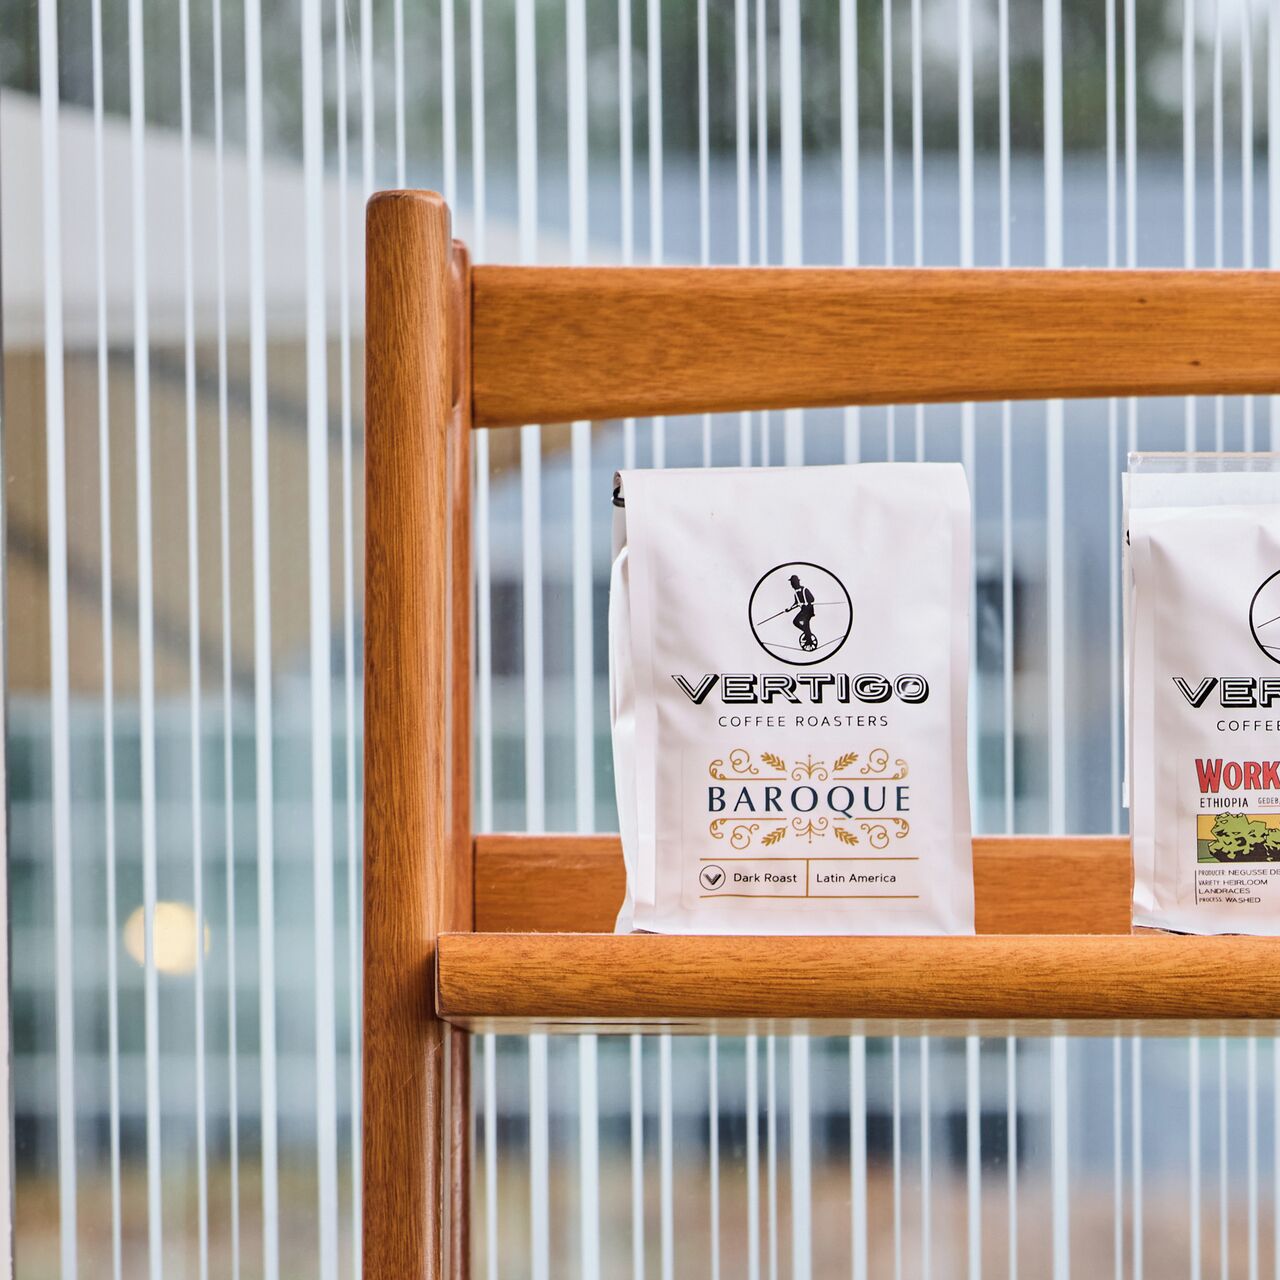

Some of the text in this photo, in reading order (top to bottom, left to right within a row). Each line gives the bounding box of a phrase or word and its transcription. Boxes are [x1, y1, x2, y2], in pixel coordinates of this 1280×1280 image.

[671, 673, 929, 704] VERTIGO
[718, 715, 888, 727] COFFEE ROASTERS
[708, 786, 910, 819] BAROQUE
[1200, 798, 1248, 808] ETHIOPIA
[734, 874, 797, 883] Dark Roast
[817, 874, 896, 883] Latin America
